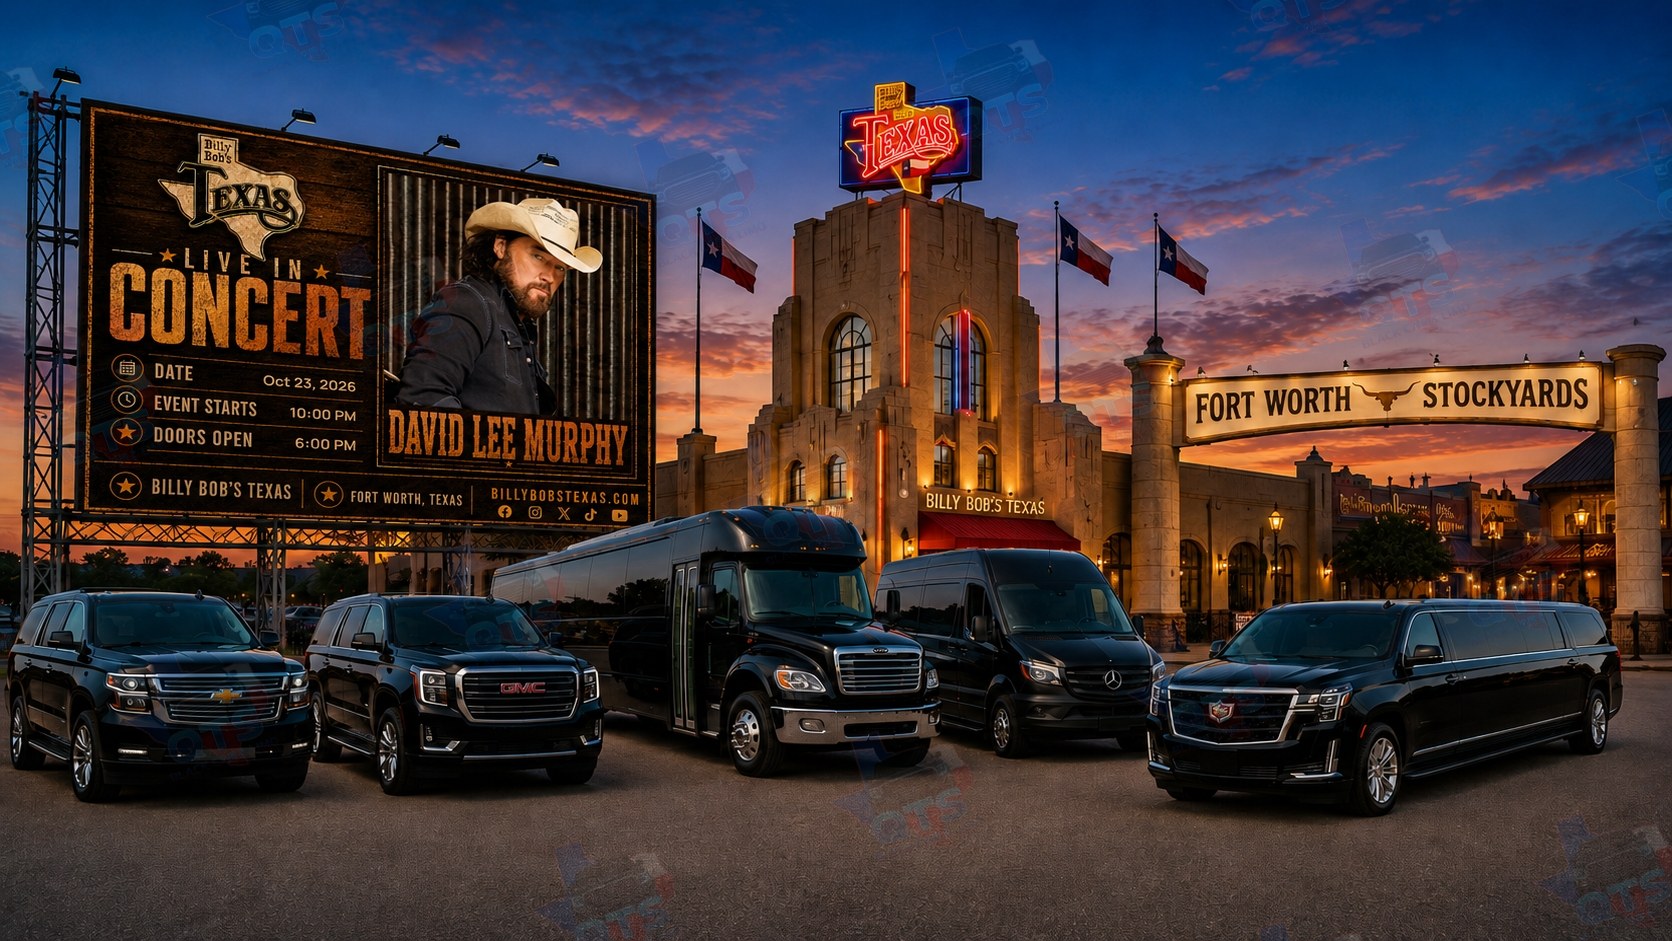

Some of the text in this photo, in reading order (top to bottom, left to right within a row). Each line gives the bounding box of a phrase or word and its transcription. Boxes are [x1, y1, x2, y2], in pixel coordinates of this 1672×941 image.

[204, 150, 232, 164] Bob's
[852, 114, 954, 179] TEXAS
[177, 161, 299, 231] TEXAS
[184, 248, 301, 281] LIVE IN
[109, 261, 372, 360] CONCERT
[155, 363, 194, 382] DATE
[263, 375, 357, 393] Oct 23, 2026
[154, 395, 258, 418] EVENT STARTS
[1195, 377, 1590, 424] FORT WORTH STOCKYARDS
[289, 406, 357, 423] 10:00 PM
[153, 426, 254, 448] DOORS OPEN
[295, 437, 357, 452] 6:00 PM
[388, 409, 629, 466] DAVID LEE MURPHY
[151, 478, 292, 500] BILLY BOB'S TEXAS
[350, 490, 463, 508] FORT WORTH, TEXAS
[491, 487, 640, 506] BILLYBOBSTEXAS.COM
[926, 492, 961, 511] BILLY
[1005, 499, 1046, 515] TEXAS
[500, 681, 546, 695] GMC
